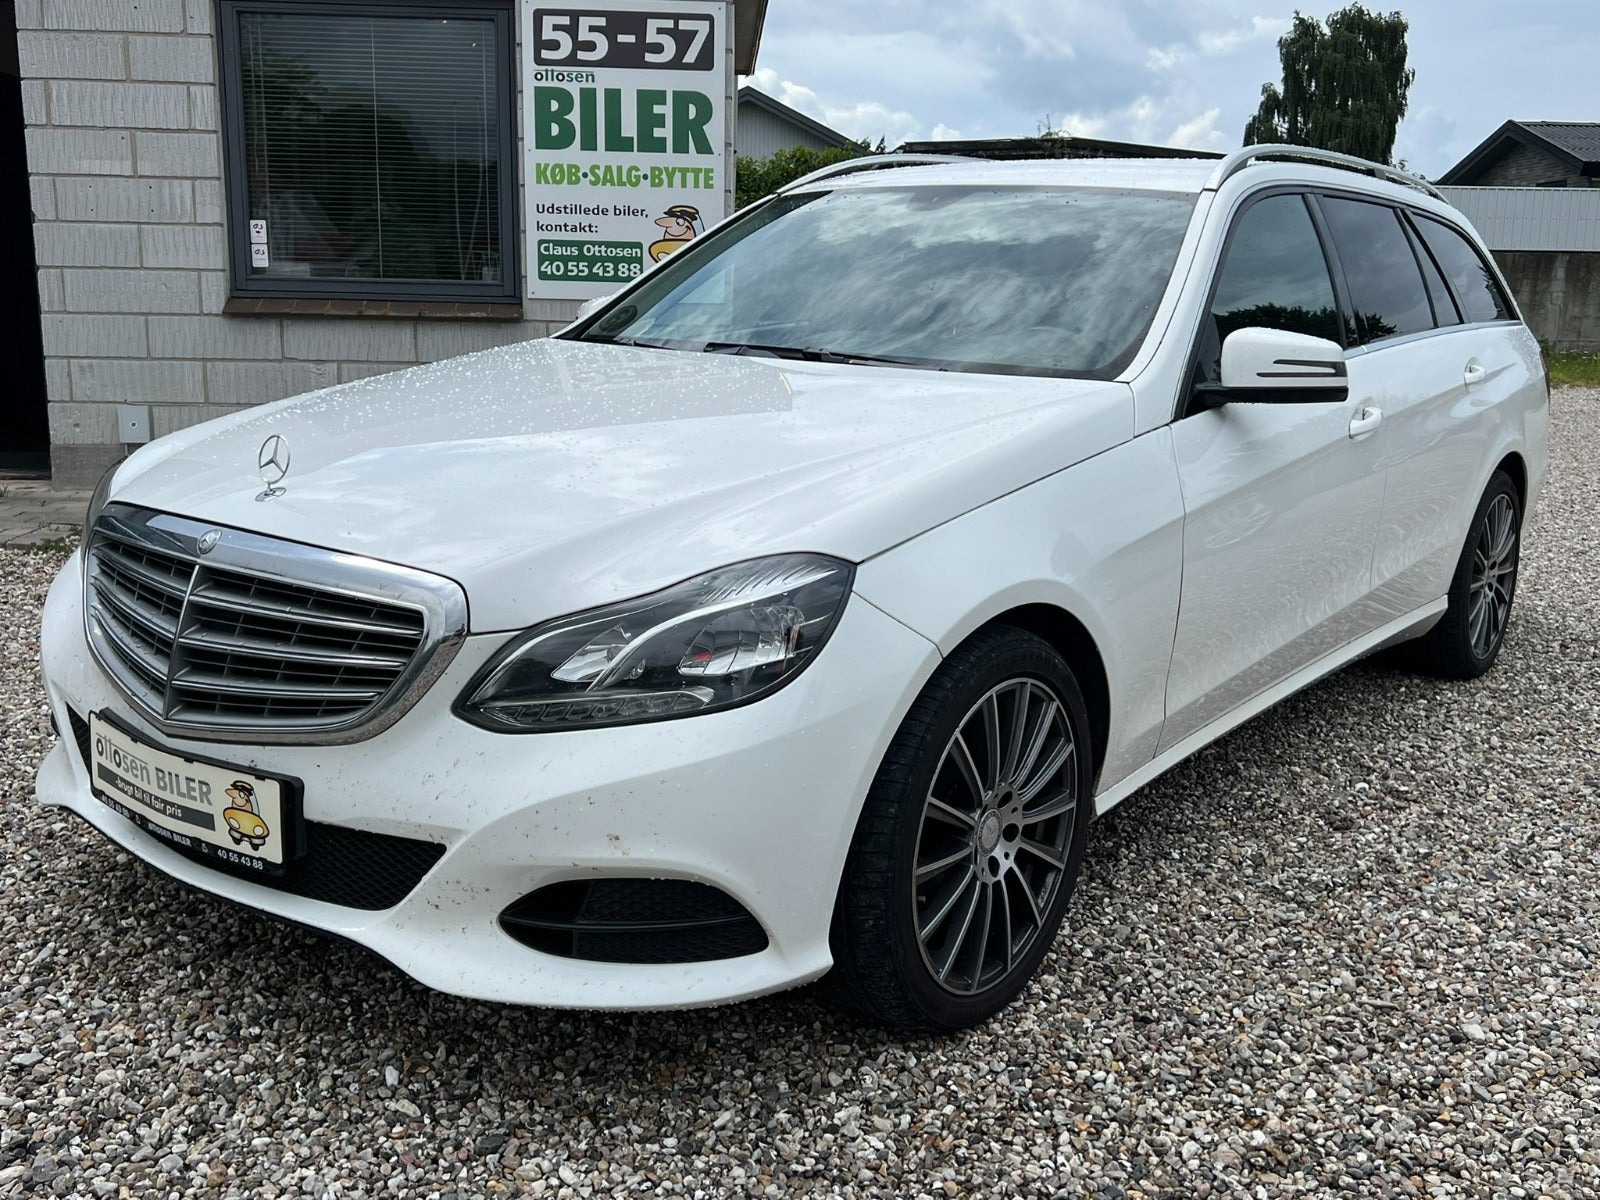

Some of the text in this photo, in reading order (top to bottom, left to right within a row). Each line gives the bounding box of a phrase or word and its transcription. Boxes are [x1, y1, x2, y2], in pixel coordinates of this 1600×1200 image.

[534, 86, 715, 155] BILER
[536, 203, 649, 219] Udstillede biler,
[536, 221, 599, 233] kontakt:
[540, 243, 641, 258] Claus Ottosen
[540, 260, 641, 277] 40 55 43 88
[155, 767, 213, 806] BILER
[151, 795, 165, 811] fair
[166, 802, 182, 817] pris
[217, 849, 263, 870] 40 55 43 88
